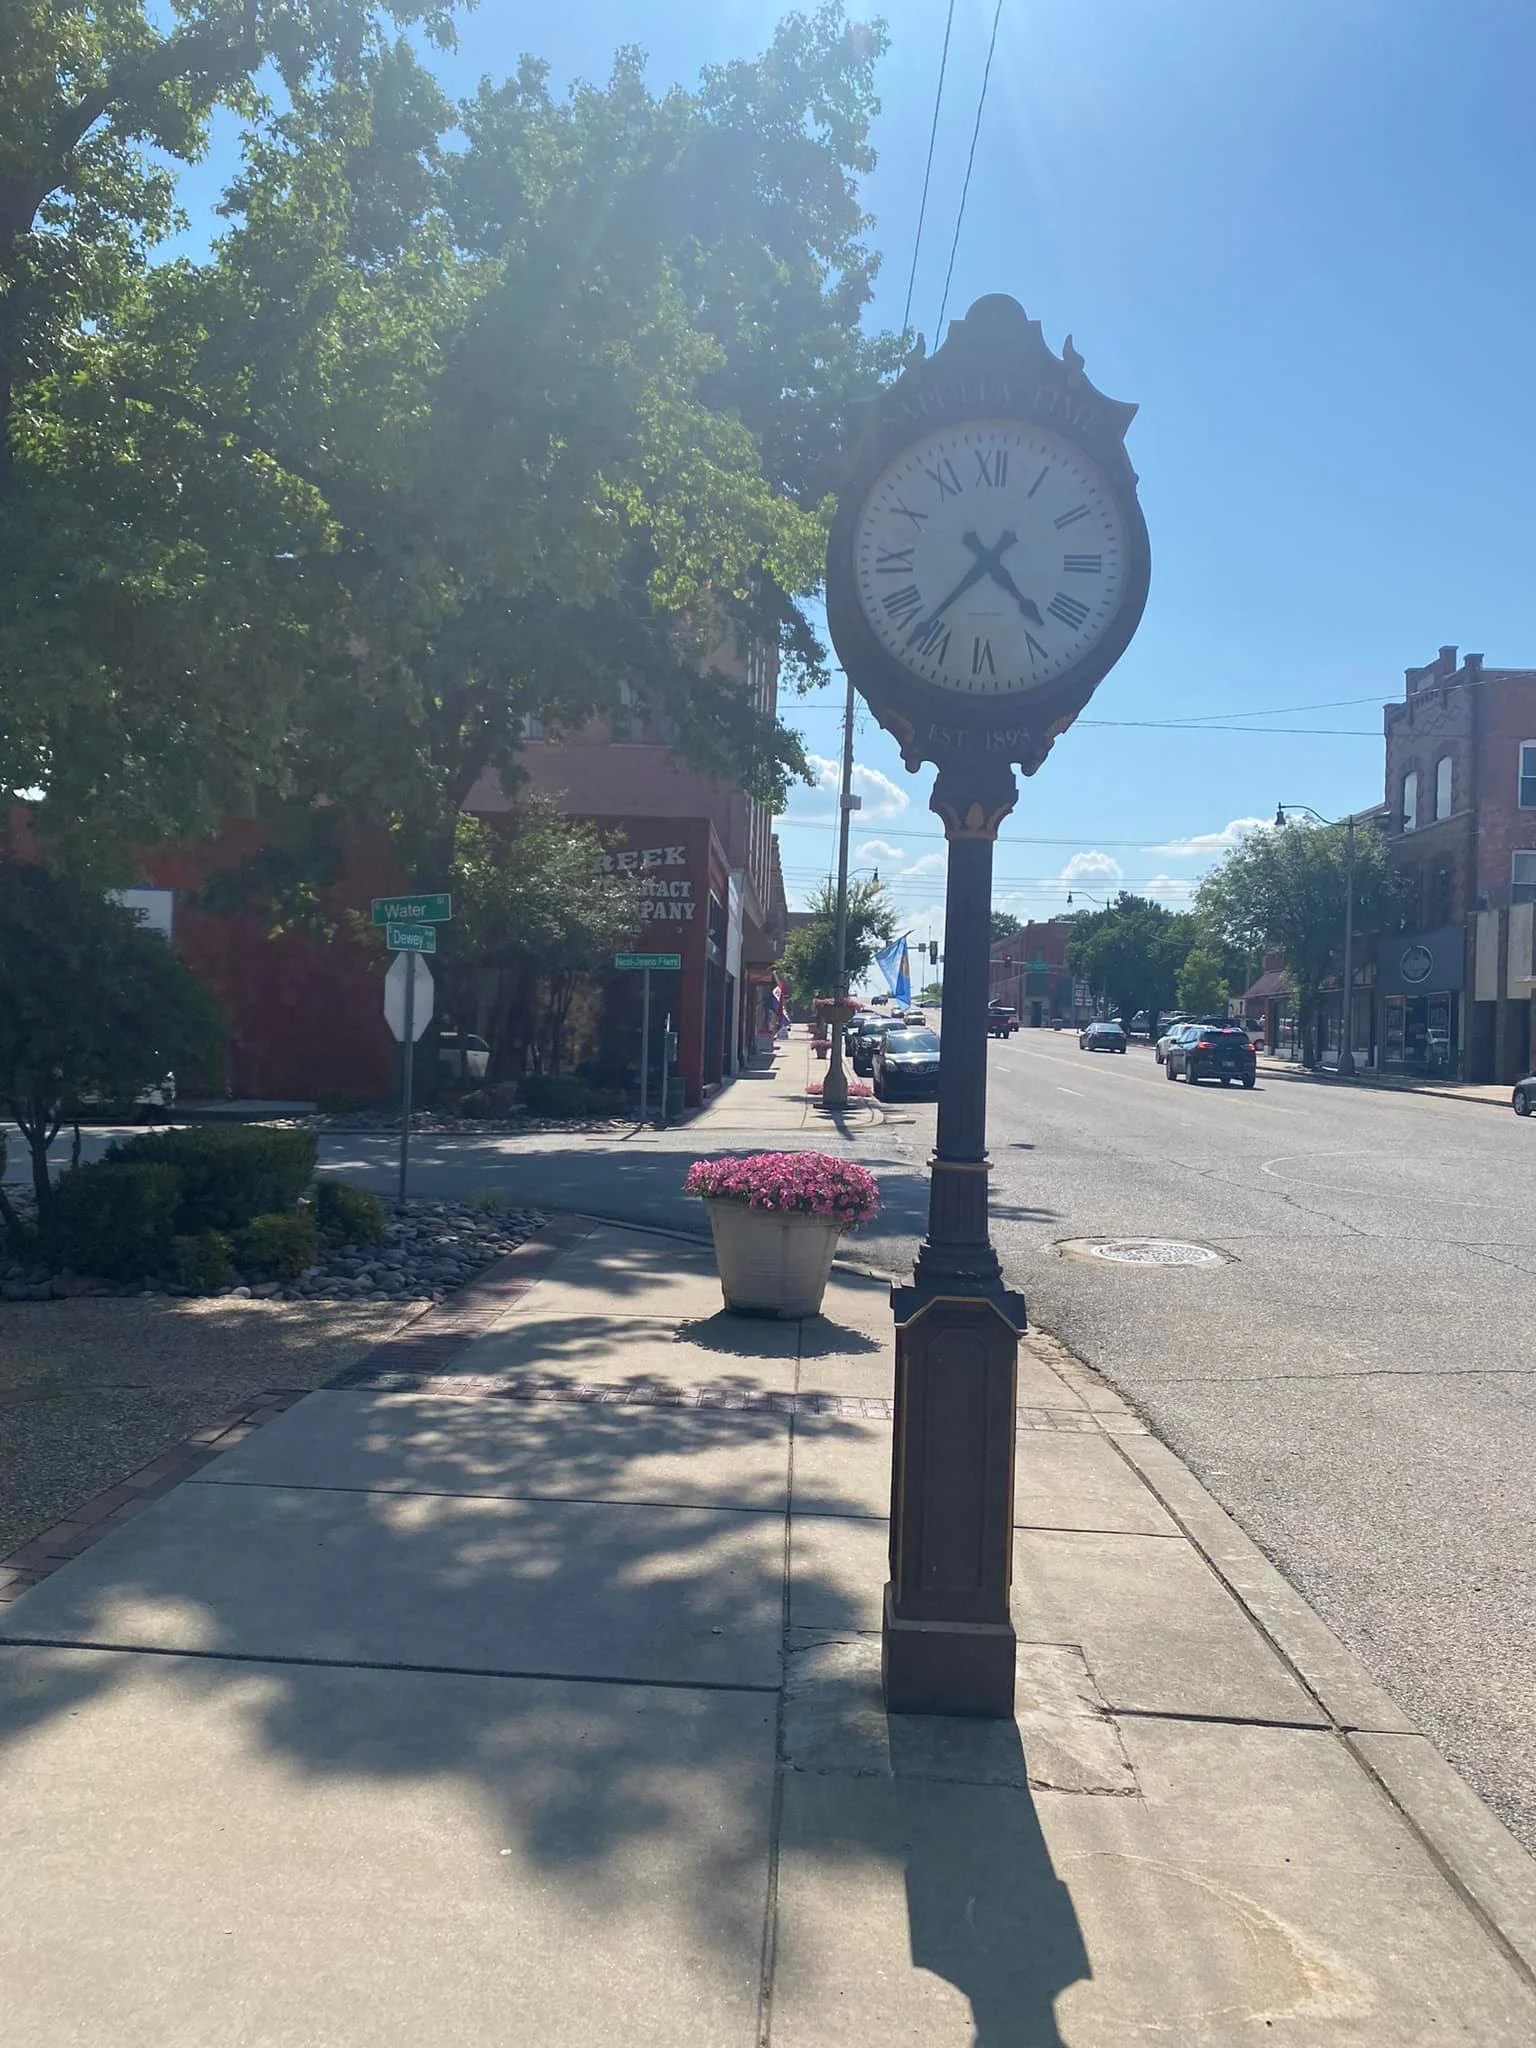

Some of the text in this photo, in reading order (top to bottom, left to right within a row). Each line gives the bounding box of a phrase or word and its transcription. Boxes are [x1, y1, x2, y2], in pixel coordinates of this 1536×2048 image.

[925, 456, 963, 503] XI
[974, 449, 1008, 488] XII
[889, 497, 929, 532] X
[1054, 503, 1091, 530] II
[876, 546, 915, 574] IX
[1064, 554, 1102, 574] III
[971, 635, 996, 676] VI
[1023, 629, 1049, 665] V
[590, 846, 687, 874] REEK
[383, 903, 427, 919] Water
[393, 929, 424, 949] Dewey
